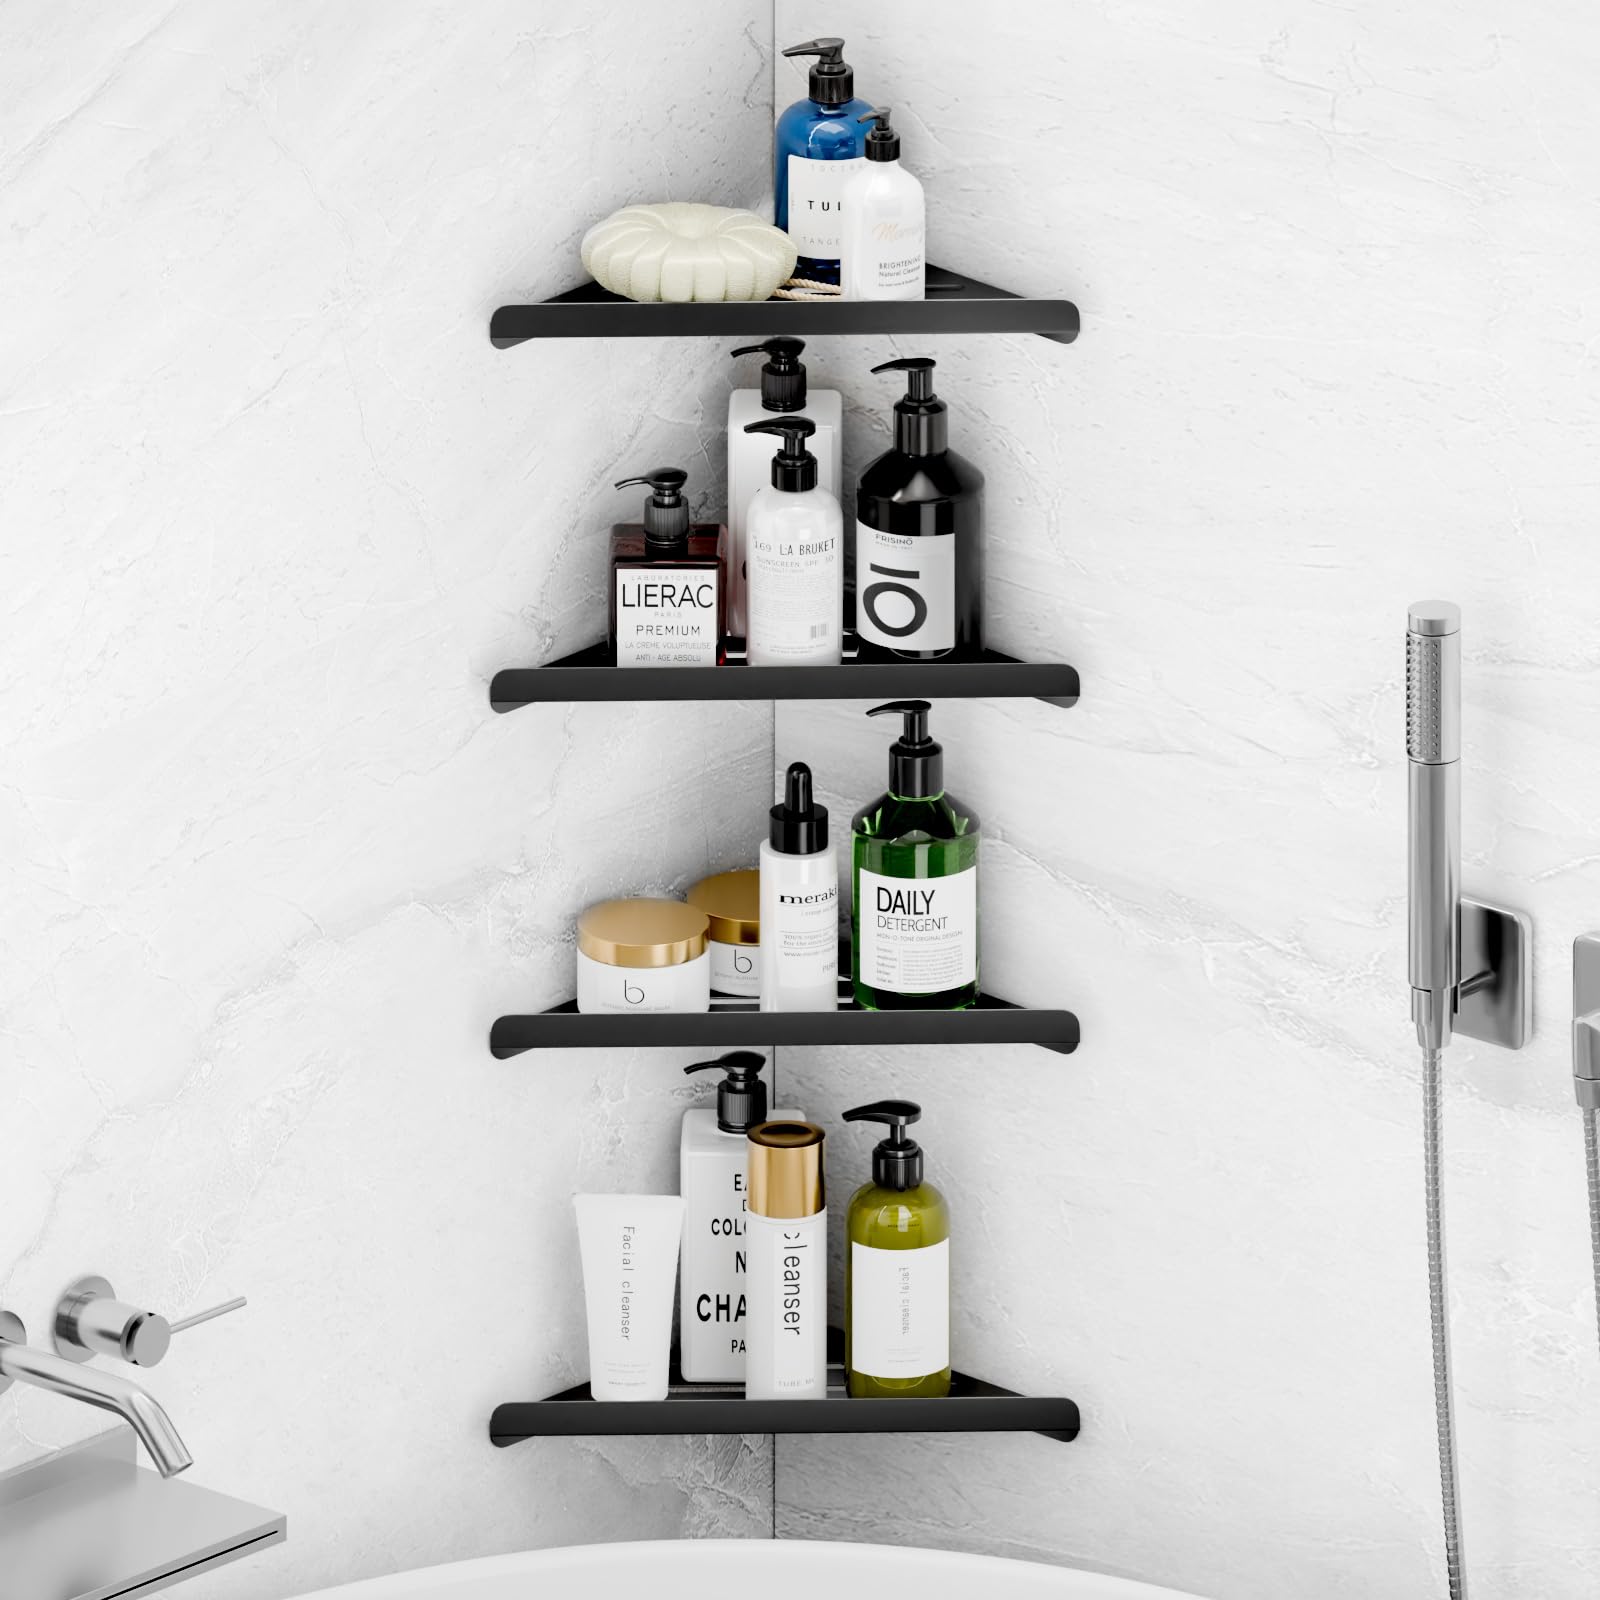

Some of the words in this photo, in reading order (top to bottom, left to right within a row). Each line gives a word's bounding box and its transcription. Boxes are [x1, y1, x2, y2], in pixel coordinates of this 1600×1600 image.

[799, 537, 835, 556] BRUKET
[622, 583, 714, 609] LIERAC
[636, 624, 701, 636] PREMIUM
[625, 641, 635, 649] LA
[876, 886, 936, 916] DAILY
[877, 915, 948, 932] DETERGENT
[733, 949, 753, 974] b
[624, 979, 645, 1004] b
[711, 1218, 747, 1236] COL
[622, 1226, 636, 1271] Facial
[620, 1280, 634, 1341] cleanser
